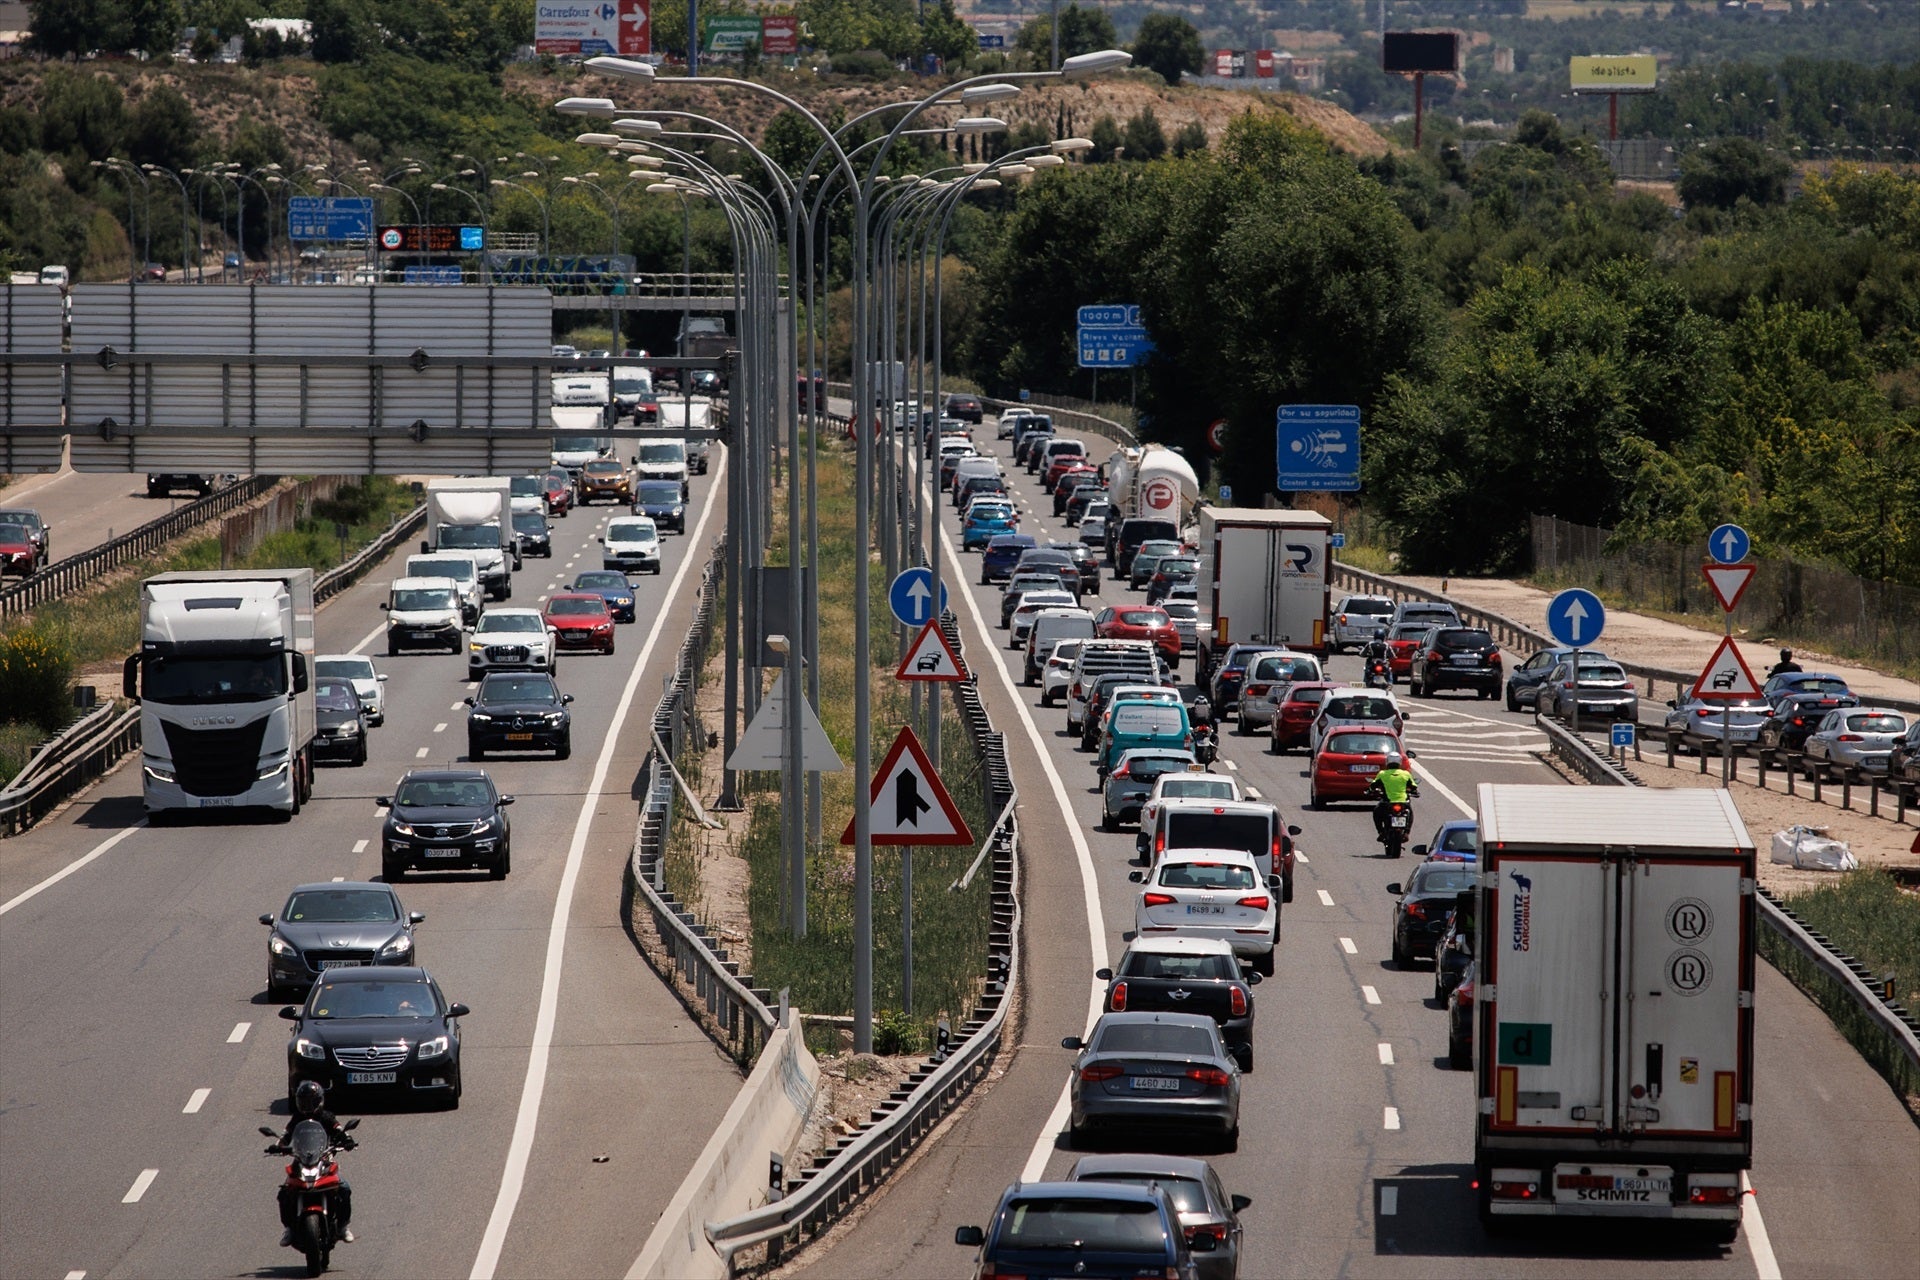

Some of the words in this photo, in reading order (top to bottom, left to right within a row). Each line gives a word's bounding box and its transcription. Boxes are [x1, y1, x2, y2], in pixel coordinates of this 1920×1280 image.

[539, 6, 590, 18] Carrefour
[1591, 66, 1636, 77] idealista
[1084, 312, 1110, 320] 1000
[1281, 408, 1296, 417] Por
[1314, 408, 1356, 418] seguridad
[192, 716, 236, 725] IVECO
[1619, 734, 1627, 743] 5
[1512, 894, 1523, 952] SCHMITZ
[1522, 895, 1531, 952] CARGOBULL
[1512, 1029, 1532, 1057] d
[352, 1073, 375, 1082] 4185
[376, 1072, 395, 1081] KNV
[1135, 1079, 1159, 1088] 4460
[1161, 1079, 1179, 1089] JJS
[1577, 1189, 1651, 1202] SCHMITZ
